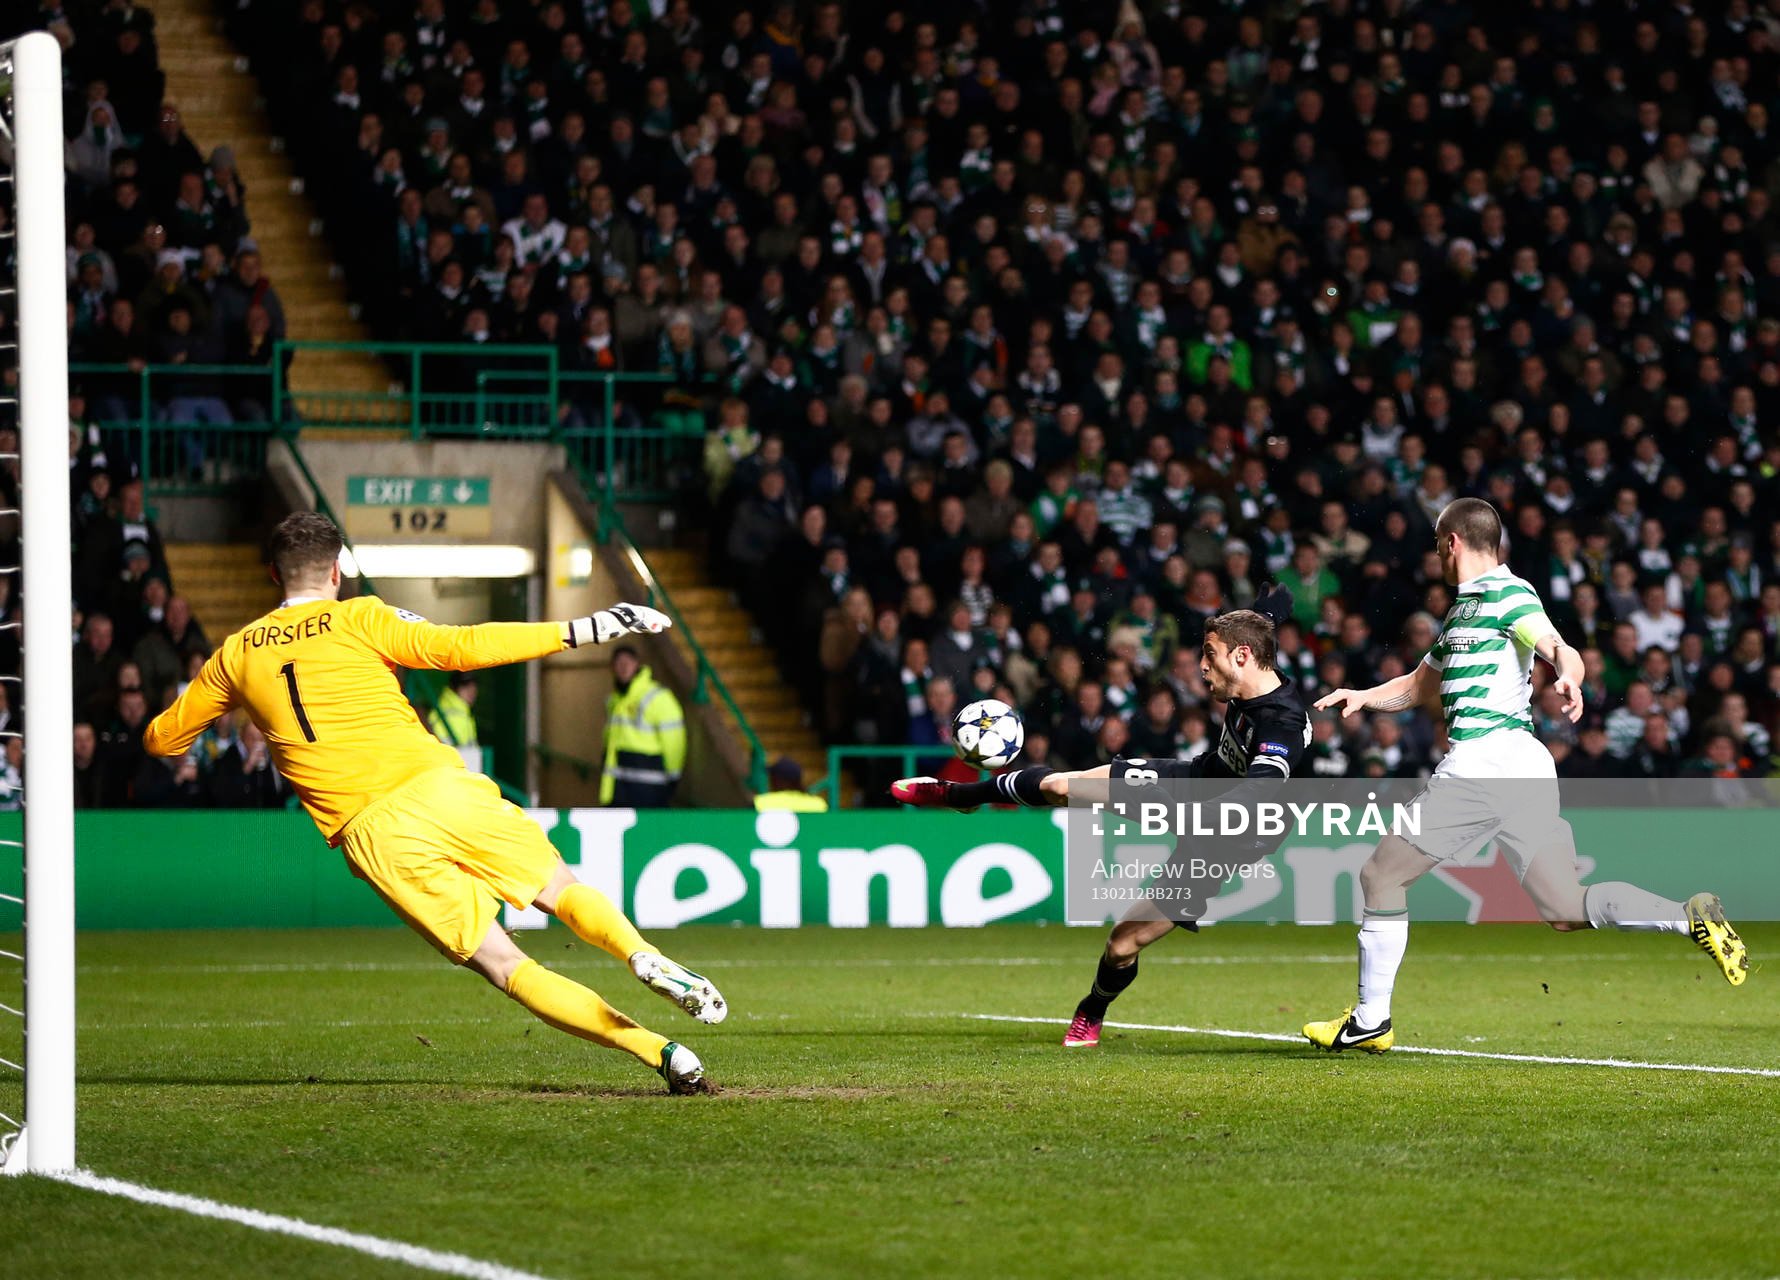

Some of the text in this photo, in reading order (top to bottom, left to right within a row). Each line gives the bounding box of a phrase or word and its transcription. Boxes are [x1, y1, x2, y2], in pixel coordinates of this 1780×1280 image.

[364, 480, 414, 504] EXIT
[391, 509, 447, 532] 102
[243, 612, 332, 653] FORSTER
[277, 659, 320, 743] 1
